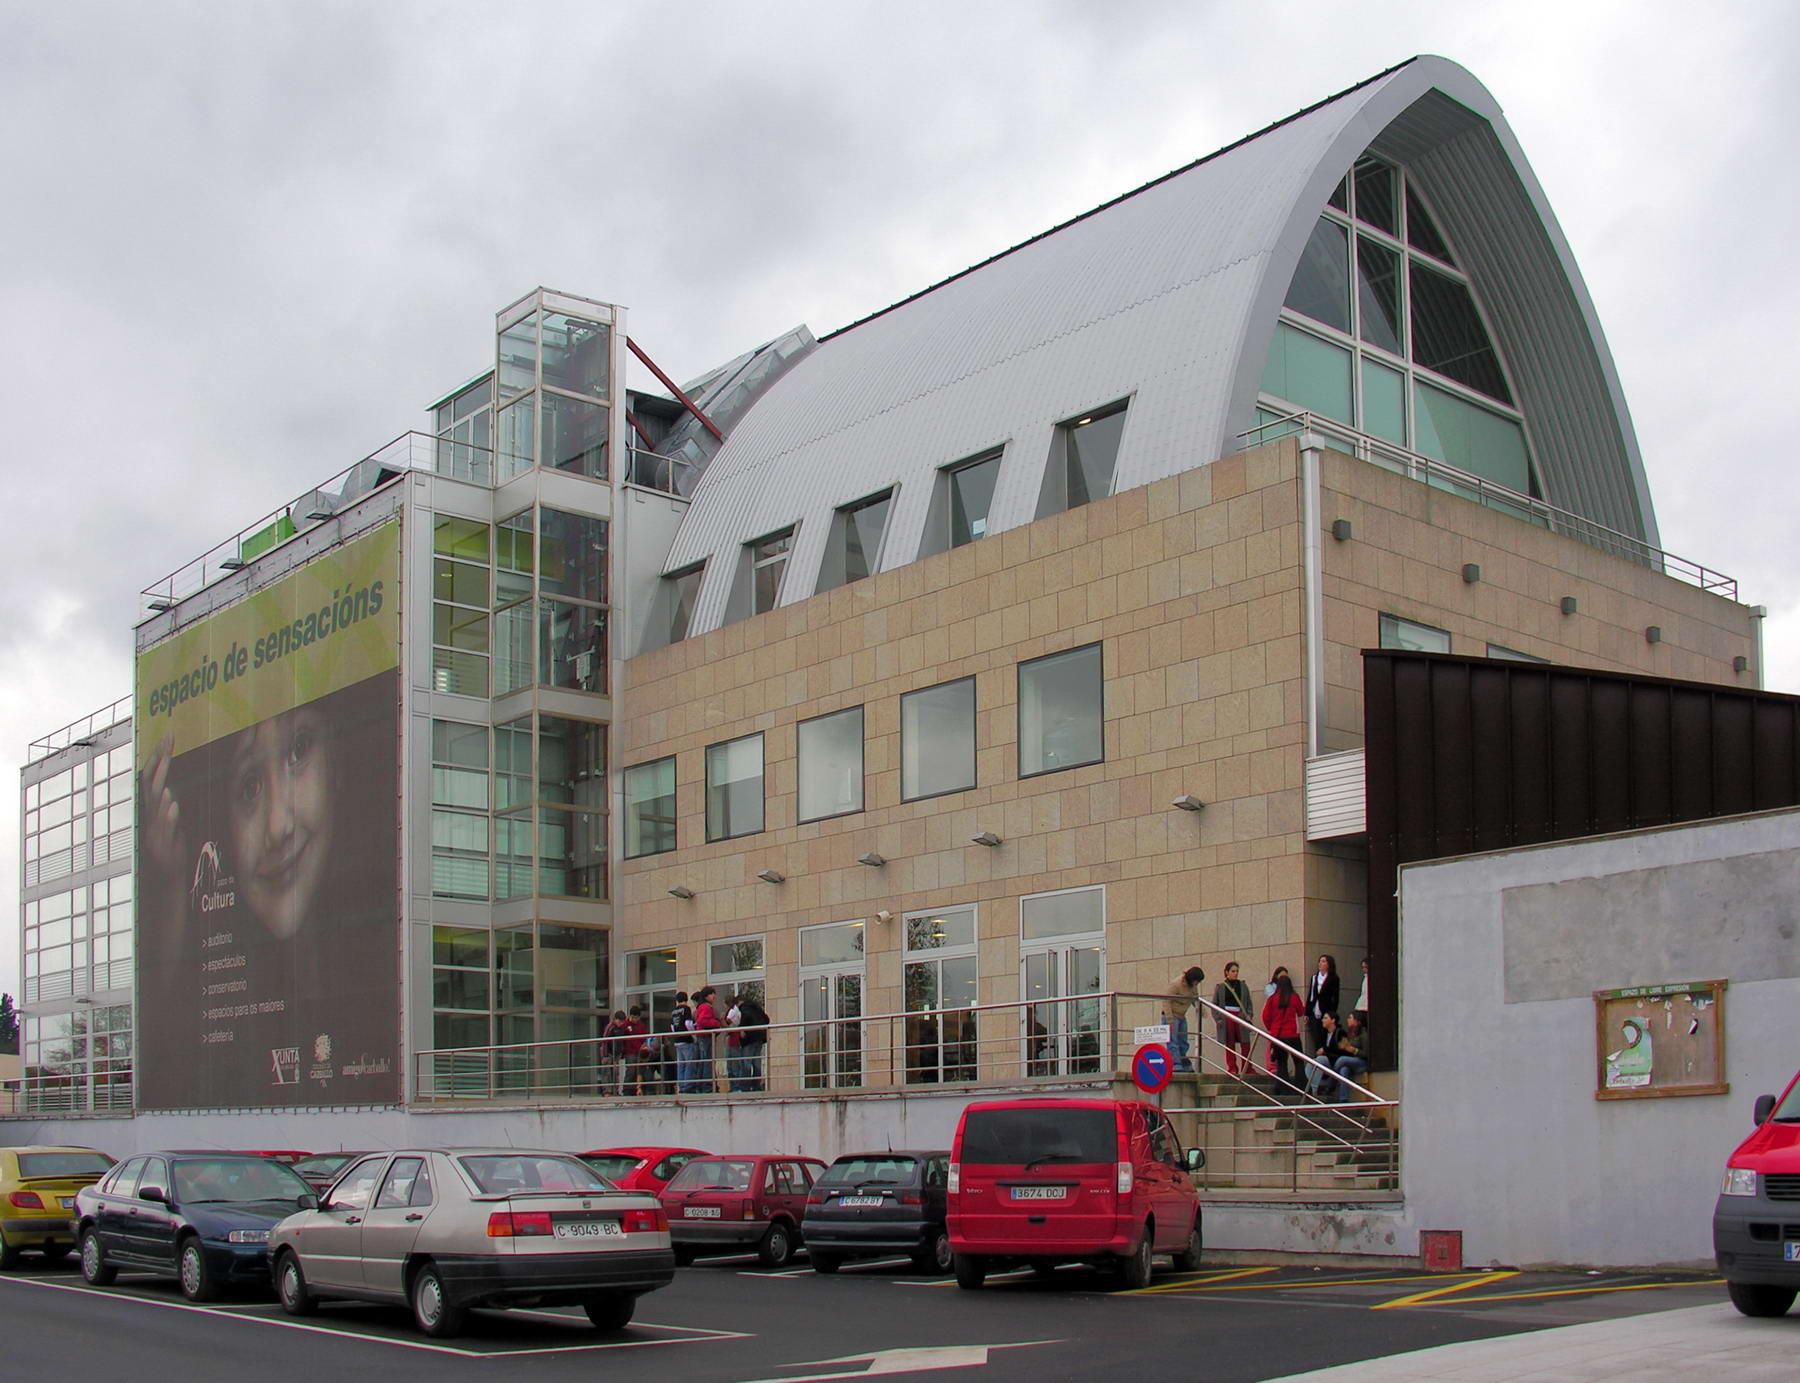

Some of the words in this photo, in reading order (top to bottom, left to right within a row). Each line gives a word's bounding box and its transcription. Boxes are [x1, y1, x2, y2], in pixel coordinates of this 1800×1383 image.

[149, 655, 218, 717] espacio
[224, 641, 248, 683] de
[253, 580, 384, 669] sensacións
[201, 891, 235, 912] Cultura
[208, 931, 233, 947] auditorio
[208, 977, 247, 995] conservatorio
[235, 1005, 249, 1019] para
[1018, 1188, 1042, 1198] 3674
